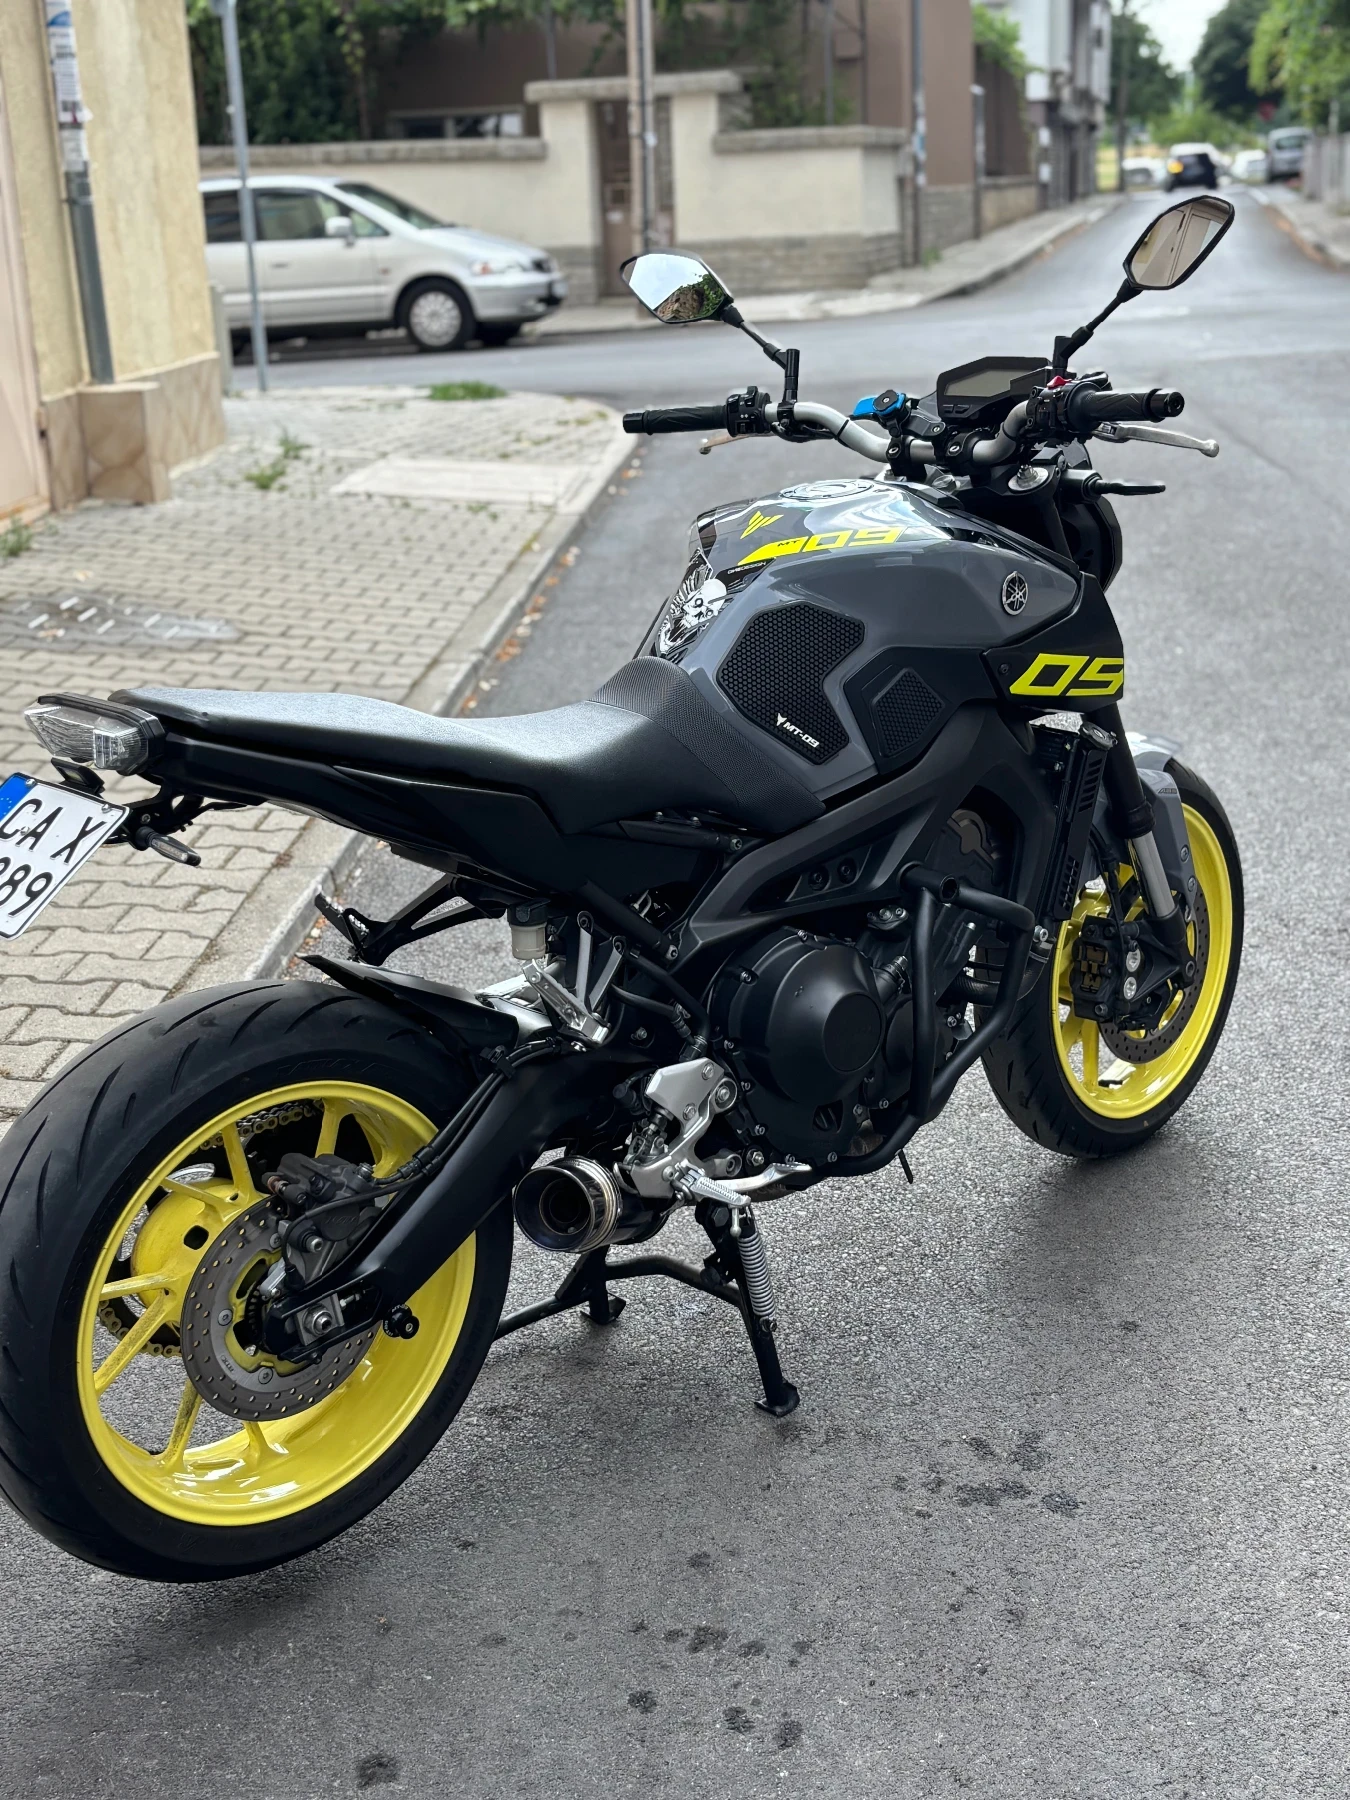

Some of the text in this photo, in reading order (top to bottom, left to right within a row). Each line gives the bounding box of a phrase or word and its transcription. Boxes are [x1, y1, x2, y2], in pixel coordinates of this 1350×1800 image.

[802, 526, 904, 552] 09
[783, 721, 820, 748] MT-09
[0, 798, 107, 864] CA X
